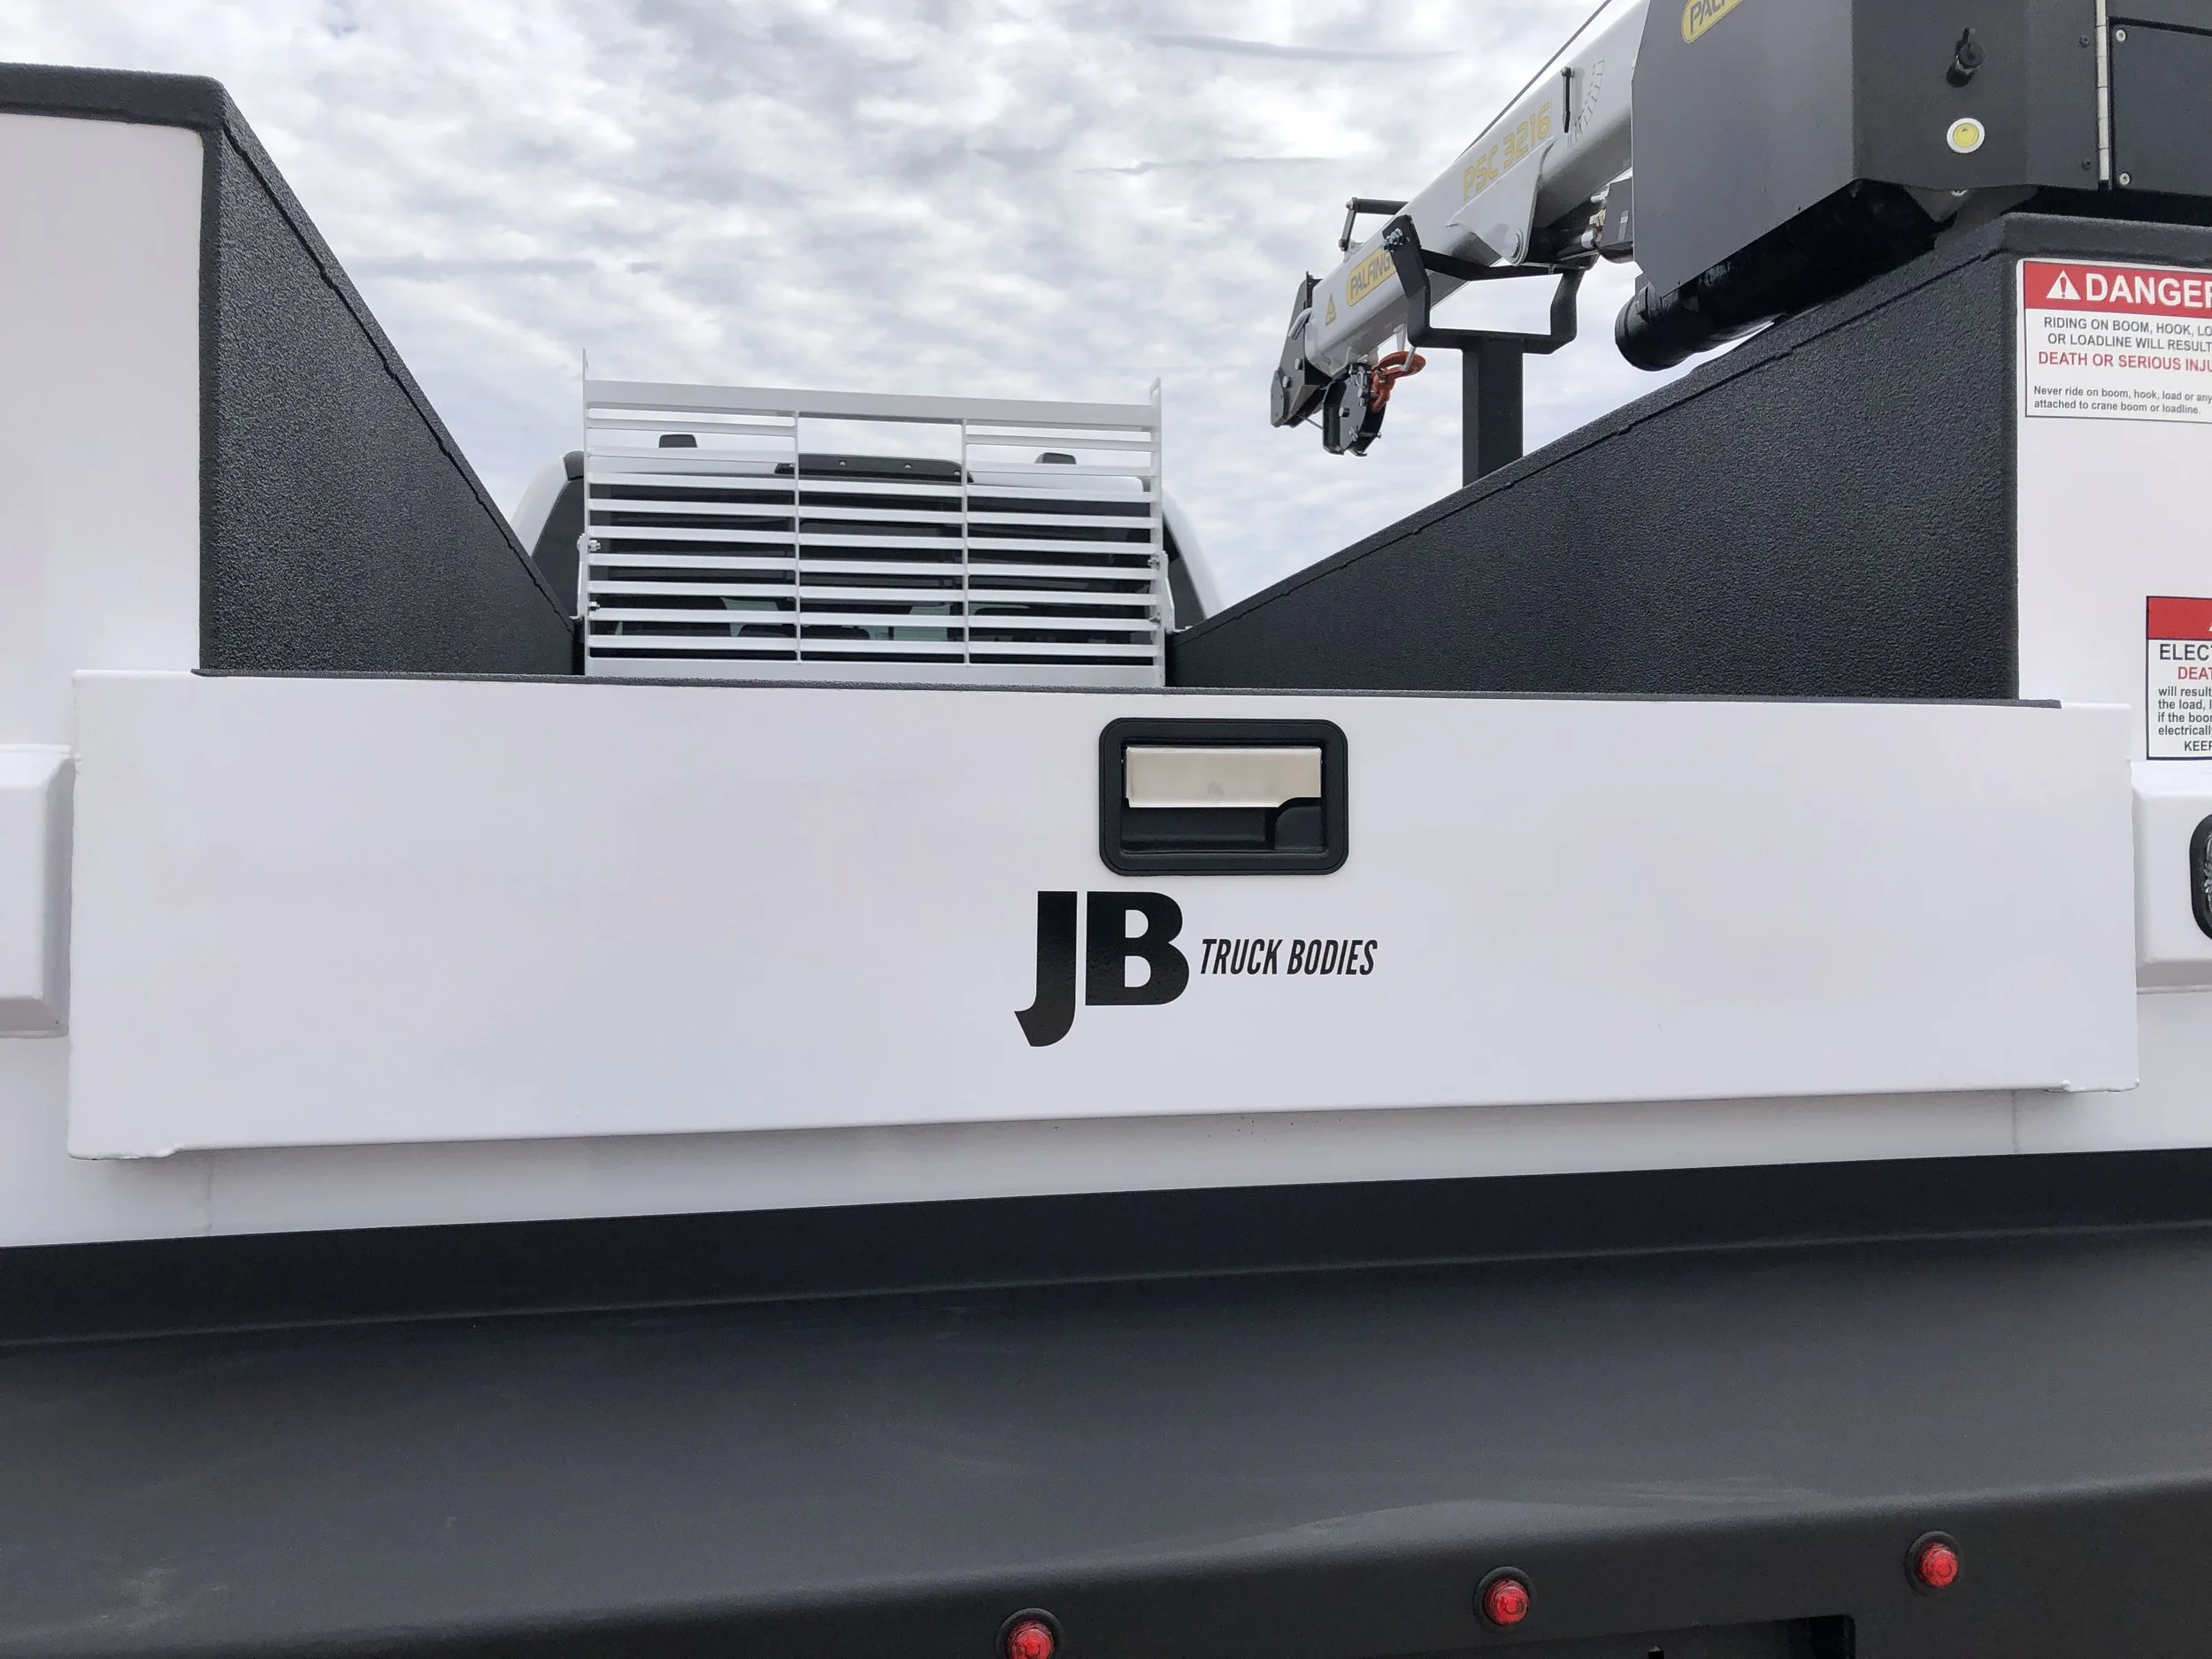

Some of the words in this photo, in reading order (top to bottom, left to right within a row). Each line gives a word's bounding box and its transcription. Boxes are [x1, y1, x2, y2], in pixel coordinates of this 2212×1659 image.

[1463, 144, 1499, 202] PSC
[1503, 101, 1551, 169] 3216
[2044, 317, 2087, 330] RIDING
[2091, 319, 2109, 331] ON
[2113, 320, 2153, 334] BOOM,
[2156, 323, 2193, 336] HOOK,
[2047, 334, 2066, 345] OR
[2070, 334, 2132, 348] LOADLINE
[2135, 337, 2164, 349] WILL
[2168, 339, 2212, 352] RESULT
[2039, 351, 2088, 365] DEATH
[2093, 354, 2114, 367] OR
[2118, 356, 2181, 371] SERIOUS
[2034, 386, 2062, 396] Never
[2065, 386, 2084, 396] ride
[2086, 388, 2099, 397] on
[2101, 388, 2131, 400] boom,
[2134, 389, 2160, 400] hook,
[2162, 390, 2182, 401] load
[2034, 399, 2077, 410] attached
[2079, 401, 2089, 410] to
[2121, 402, 2147, 411] boom
[2162, 403, 2201, 414] loadline.
[2160, 643, 2212, 662] ELEC
[2158, 686, 2177, 696] will
[2180, 686, 2212, 697] result
[2158, 698, 2176, 710] the
[2179, 698, 2206, 711] load,
[2158, 711, 2165, 723] if
[2168, 711, 2185, 723] the
[2188, 711, 2212, 723] boo
[1014, 890, 1190, 1047] JB
[1201, 938, 1283, 975] TRUCK
[1286, 938, 1379, 976] BODIES
